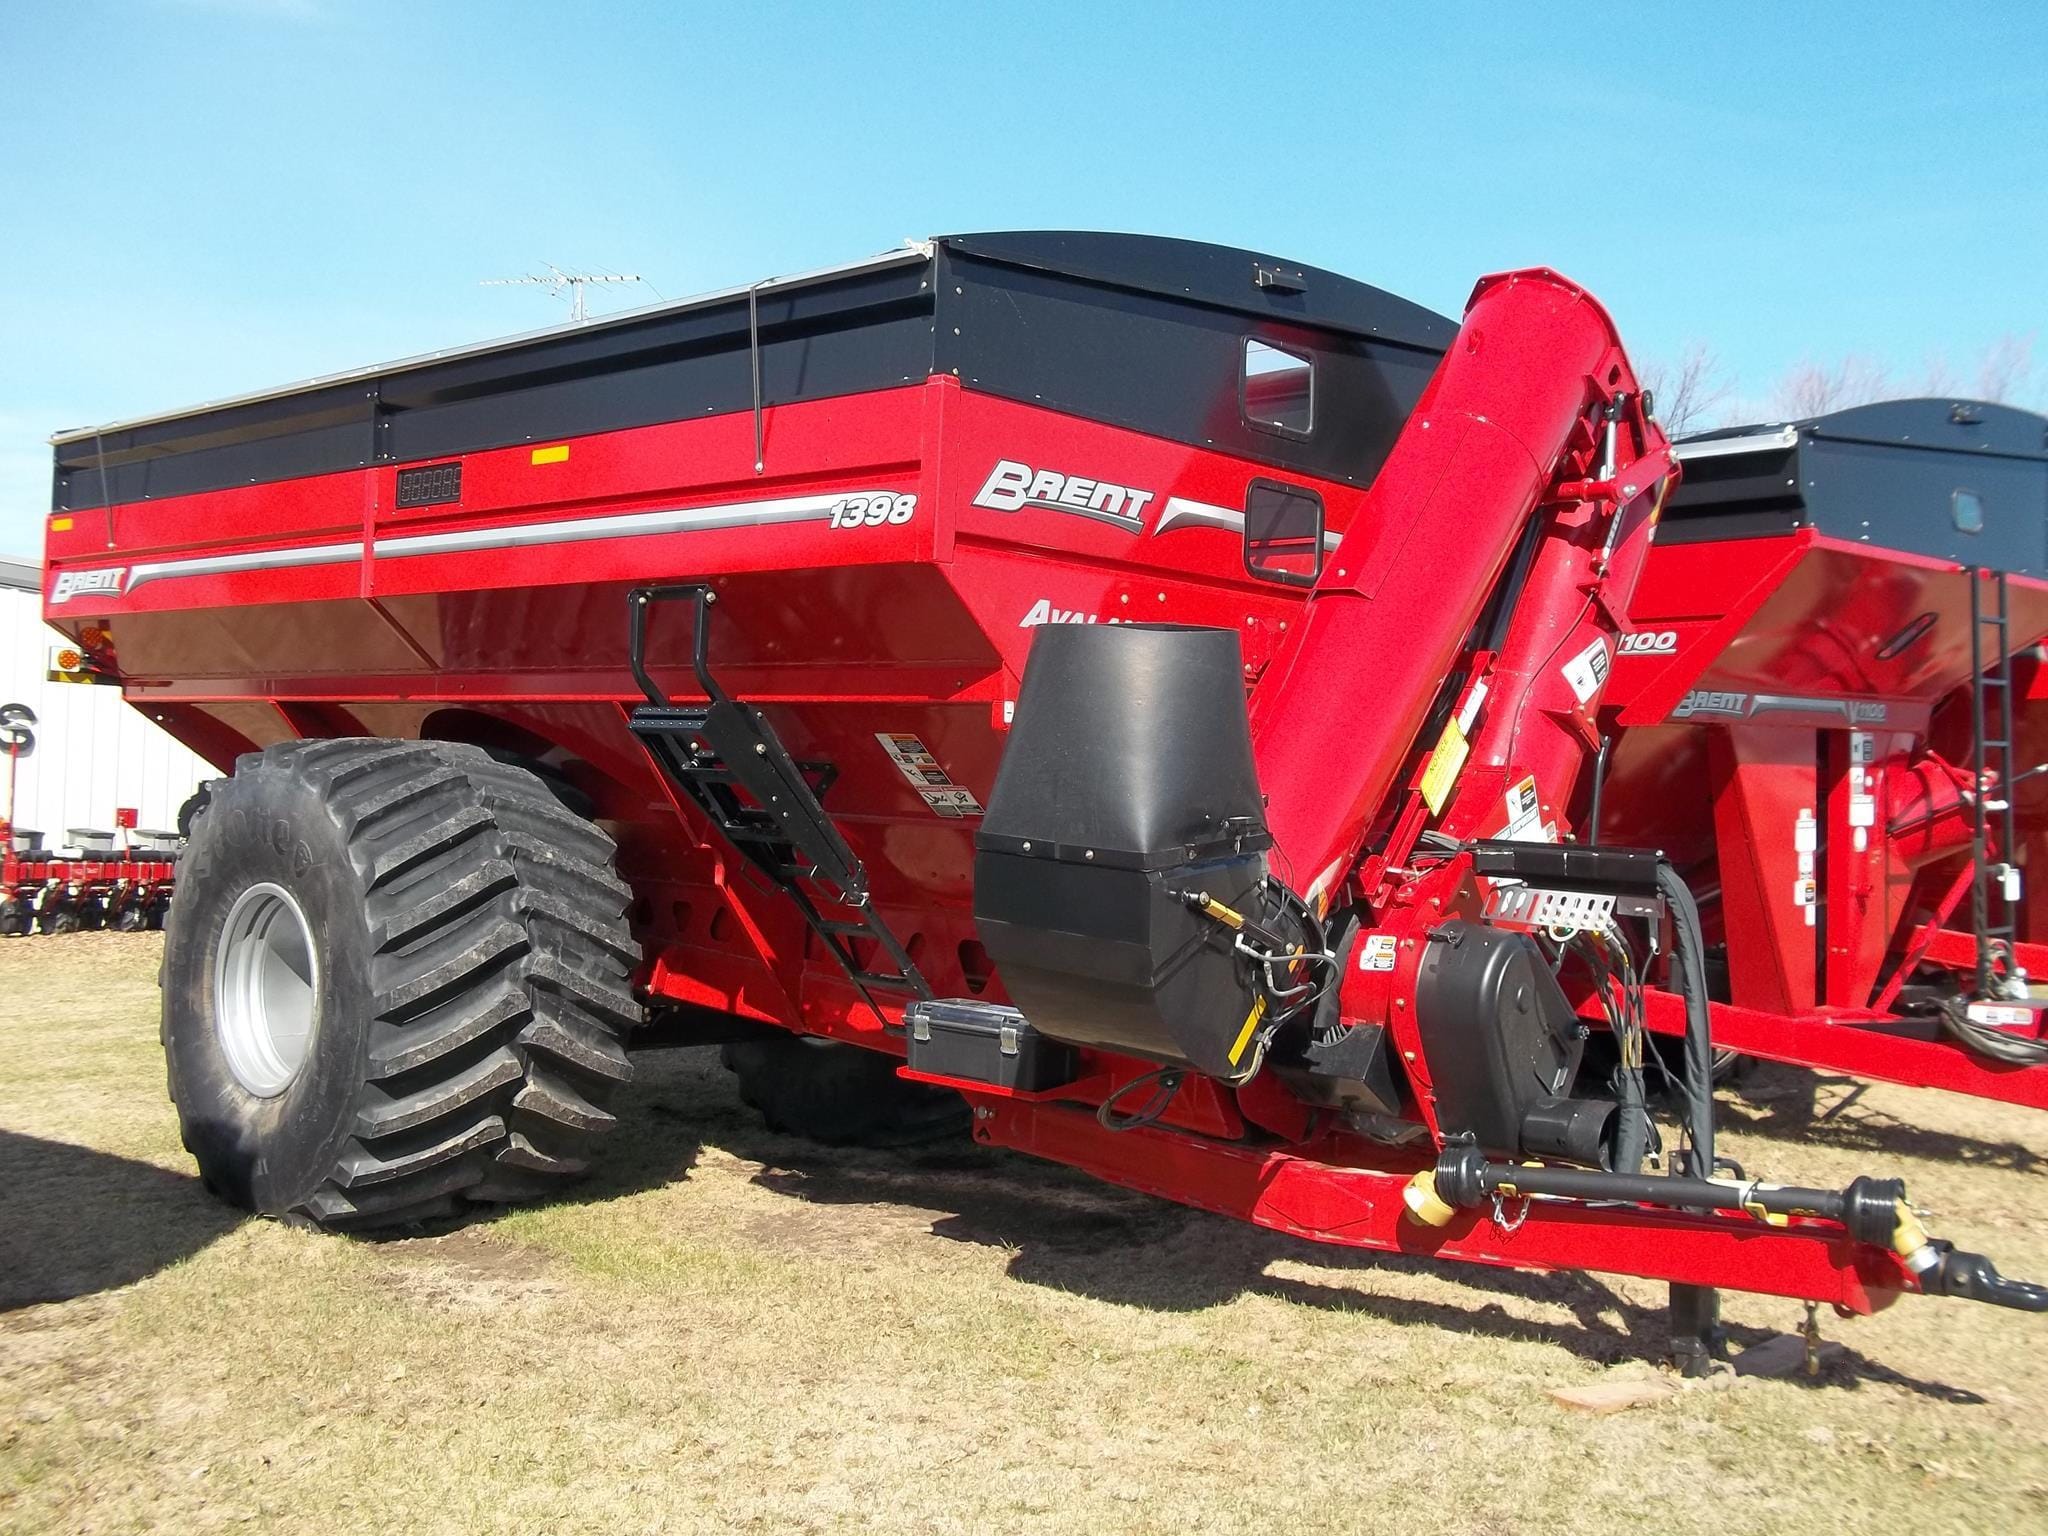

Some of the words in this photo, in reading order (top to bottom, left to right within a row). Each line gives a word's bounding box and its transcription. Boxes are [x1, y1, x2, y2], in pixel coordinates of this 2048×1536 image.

[971, 458, 1156, 519] BRENT
[829, 493, 918, 529] 1398
[50, 567, 127, 604] BRENT
[1672, 689, 1748, 718] BRENT
